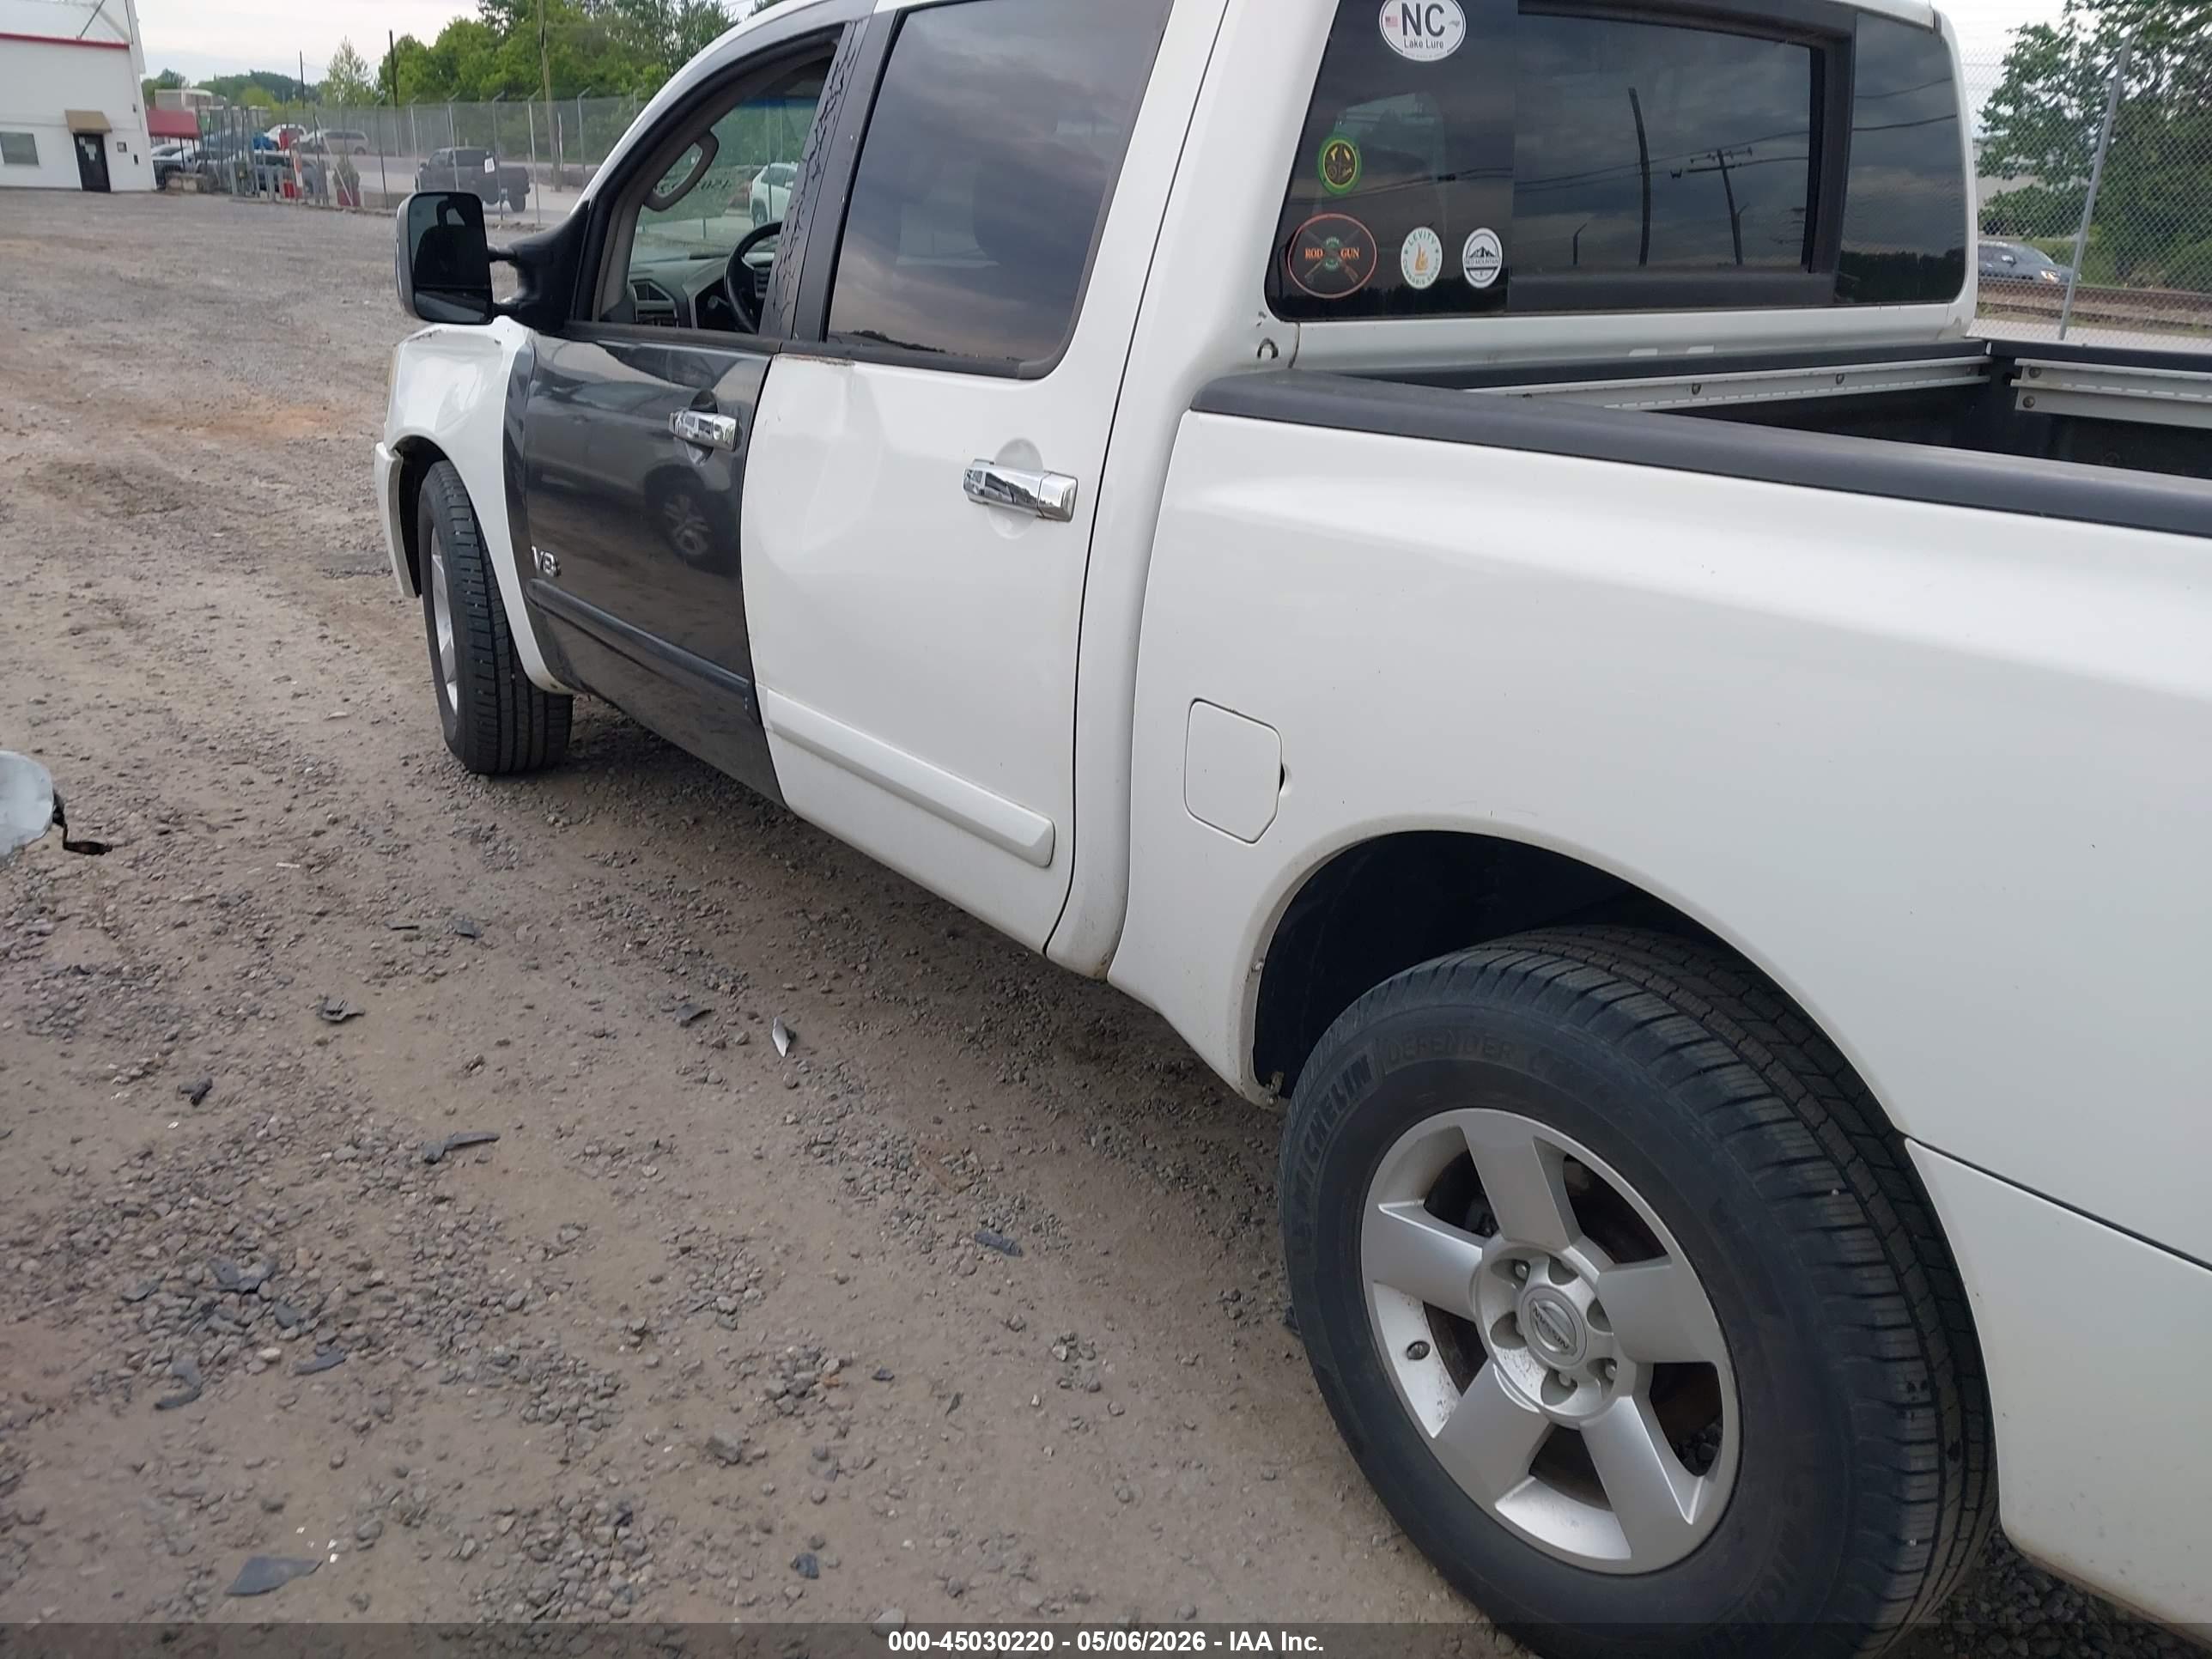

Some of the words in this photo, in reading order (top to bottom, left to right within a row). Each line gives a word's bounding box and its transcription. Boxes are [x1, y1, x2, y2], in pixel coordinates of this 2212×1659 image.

[1401, 3, 1445, 37] NC
[1403, 38, 1424, 49] Lake
[1425, 38, 1444, 49] Lure
[1304, 247, 1323, 259] ROD
[1340, 247, 1360, 259] GUN
[531, 545, 560, 577] V8
[1292, 1052, 1374, 1207] MICHELIN
[1387, 1030, 1514, 1063] DEFENDER
